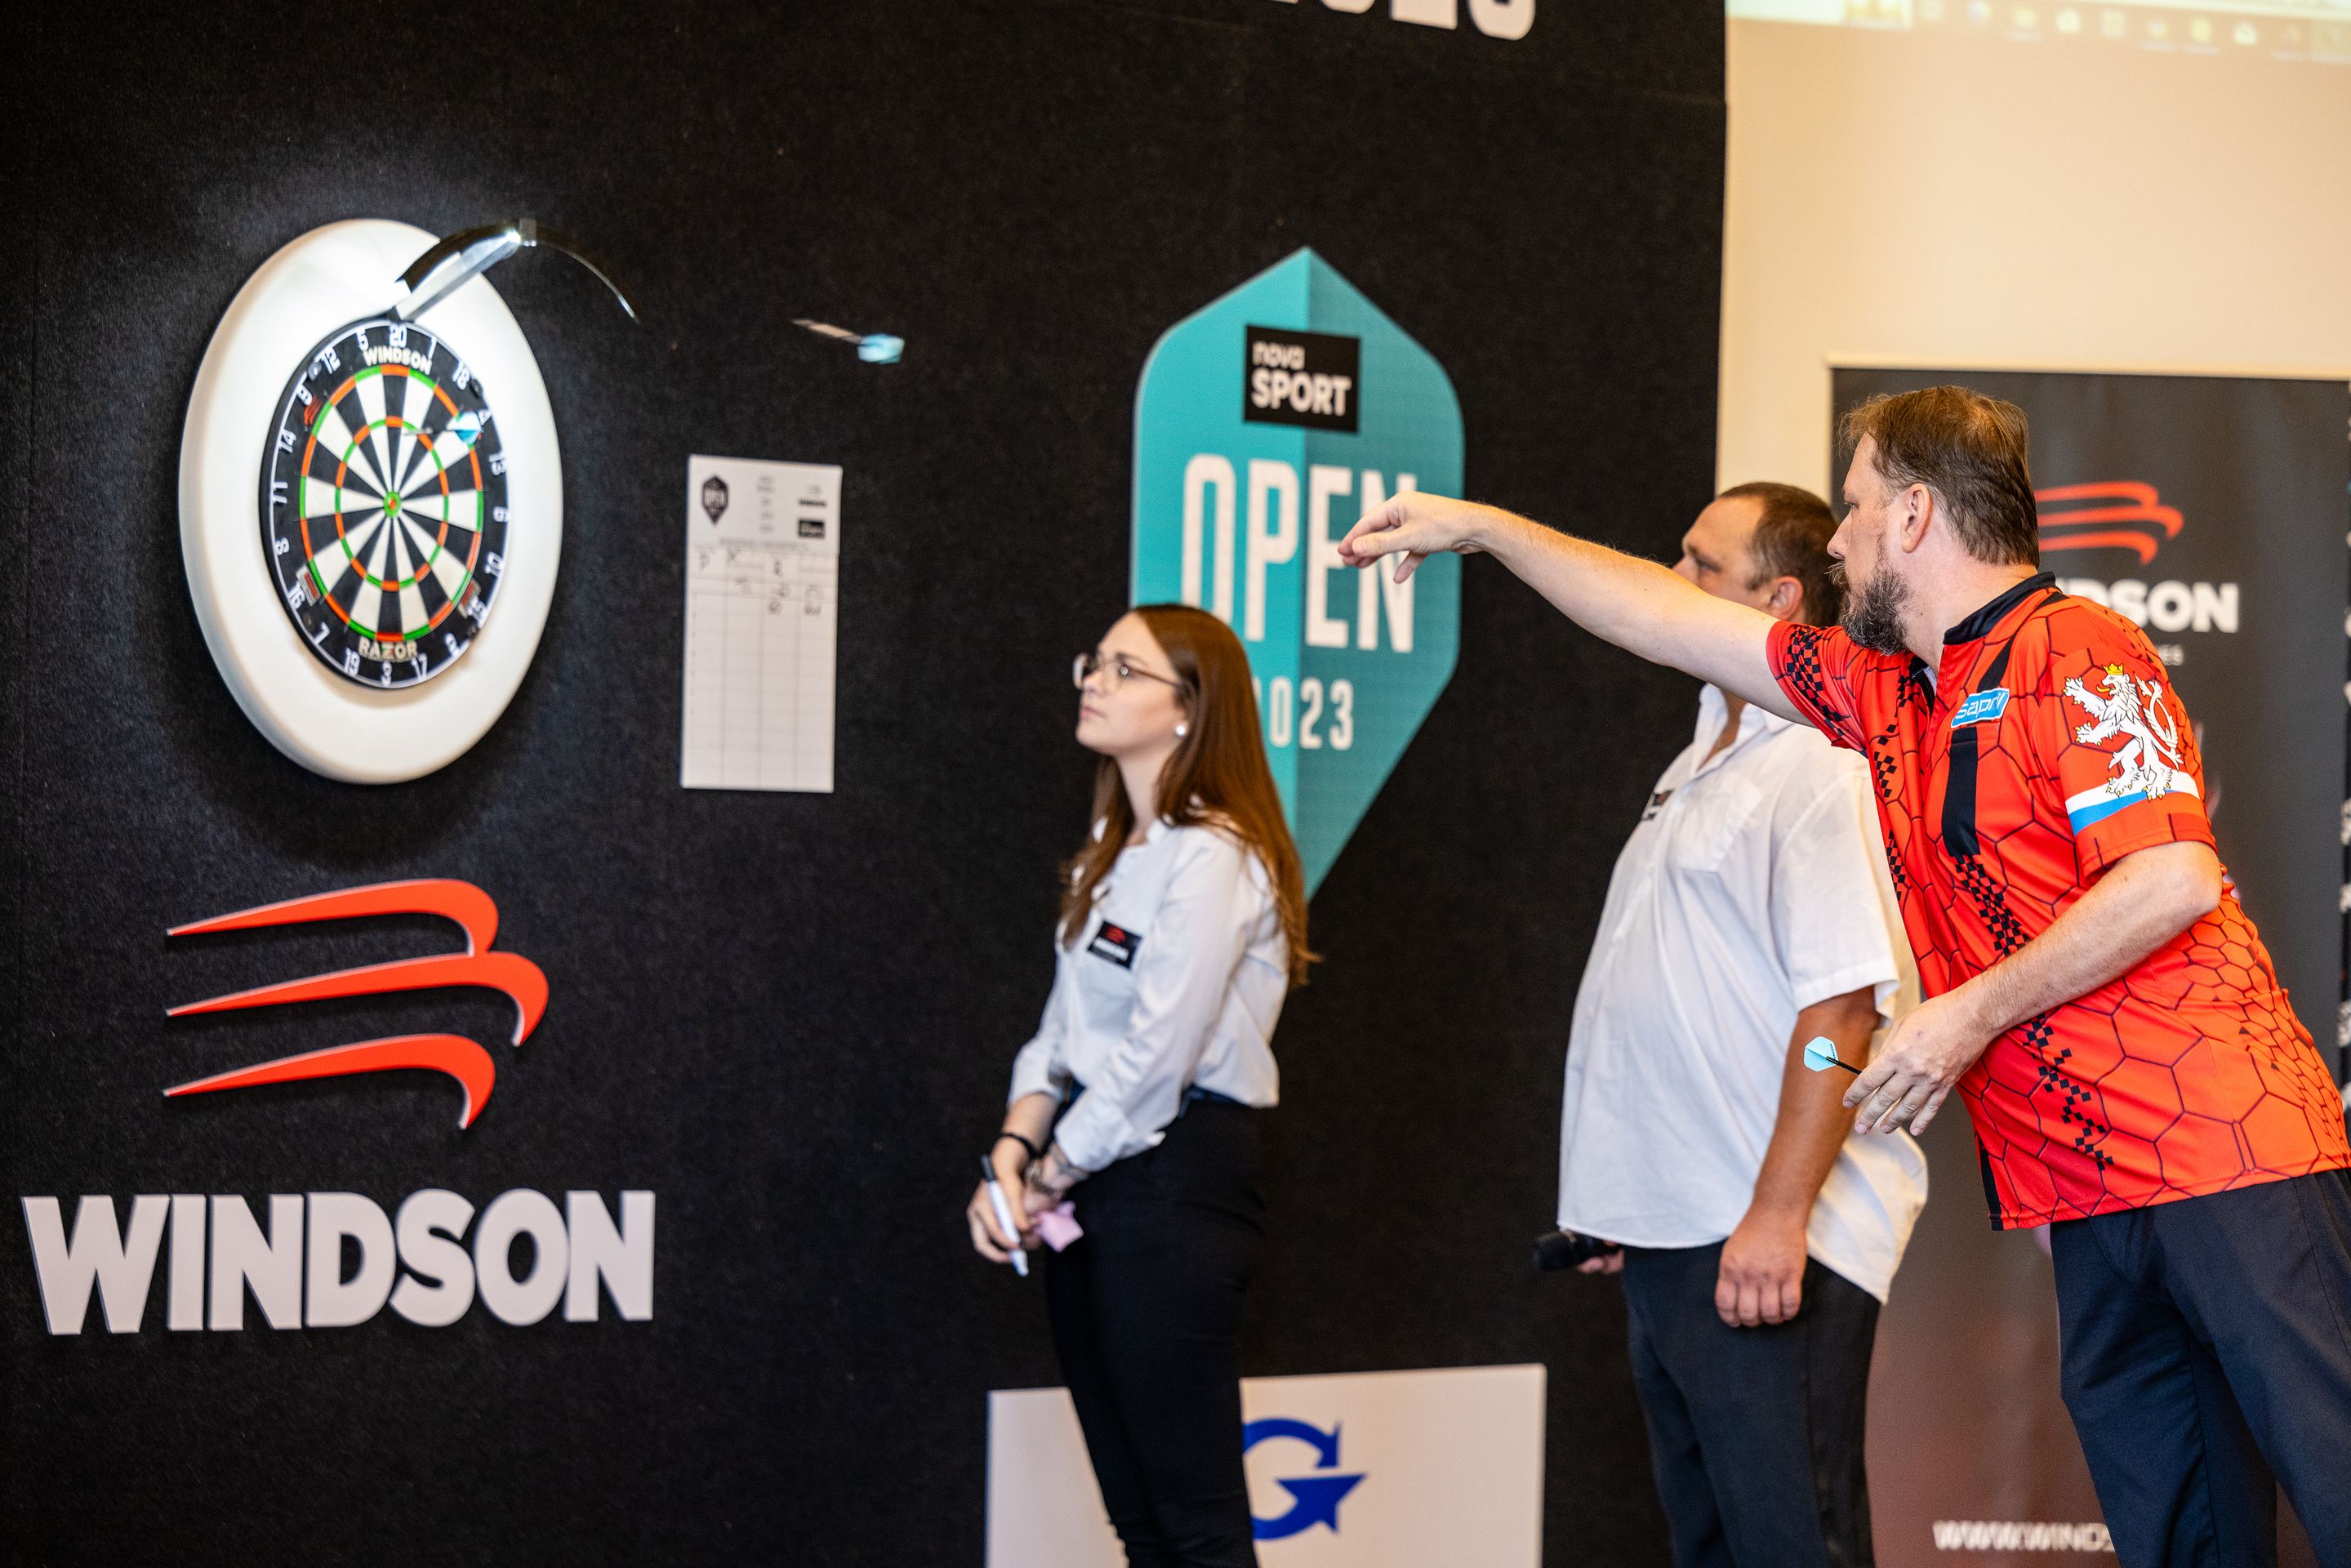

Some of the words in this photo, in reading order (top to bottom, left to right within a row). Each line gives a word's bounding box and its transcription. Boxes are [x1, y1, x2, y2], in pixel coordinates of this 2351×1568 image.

[355, 329, 369, 351] 5
[389, 326, 407, 348] 20
[428, 336, 438, 358] 1
[314, 346, 341, 374] 12
[363, 345, 433, 375] WINDSON
[1252, 341, 1306, 370] nova
[452, 361, 471, 390] 18
[1251, 367, 1352, 417] SPORT
[278, 429, 298, 453] 14
[273, 481, 288, 504] 11
[274, 537, 290, 556] 8
[1181, 454, 1417, 652] OPEN
[485, 551, 505, 577] 10
[287, 582, 305, 610] 16
[314, 622, 331, 644] 7
[358, 638, 418, 660] RAZOR
[343, 648, 361, 677] 19
[381, 661, 393, 686] 3
[411, 653, 429, 679] 17
[1253, 675, 1354, 751] 023
[20, 1188, 655, 1335] WINDSON
